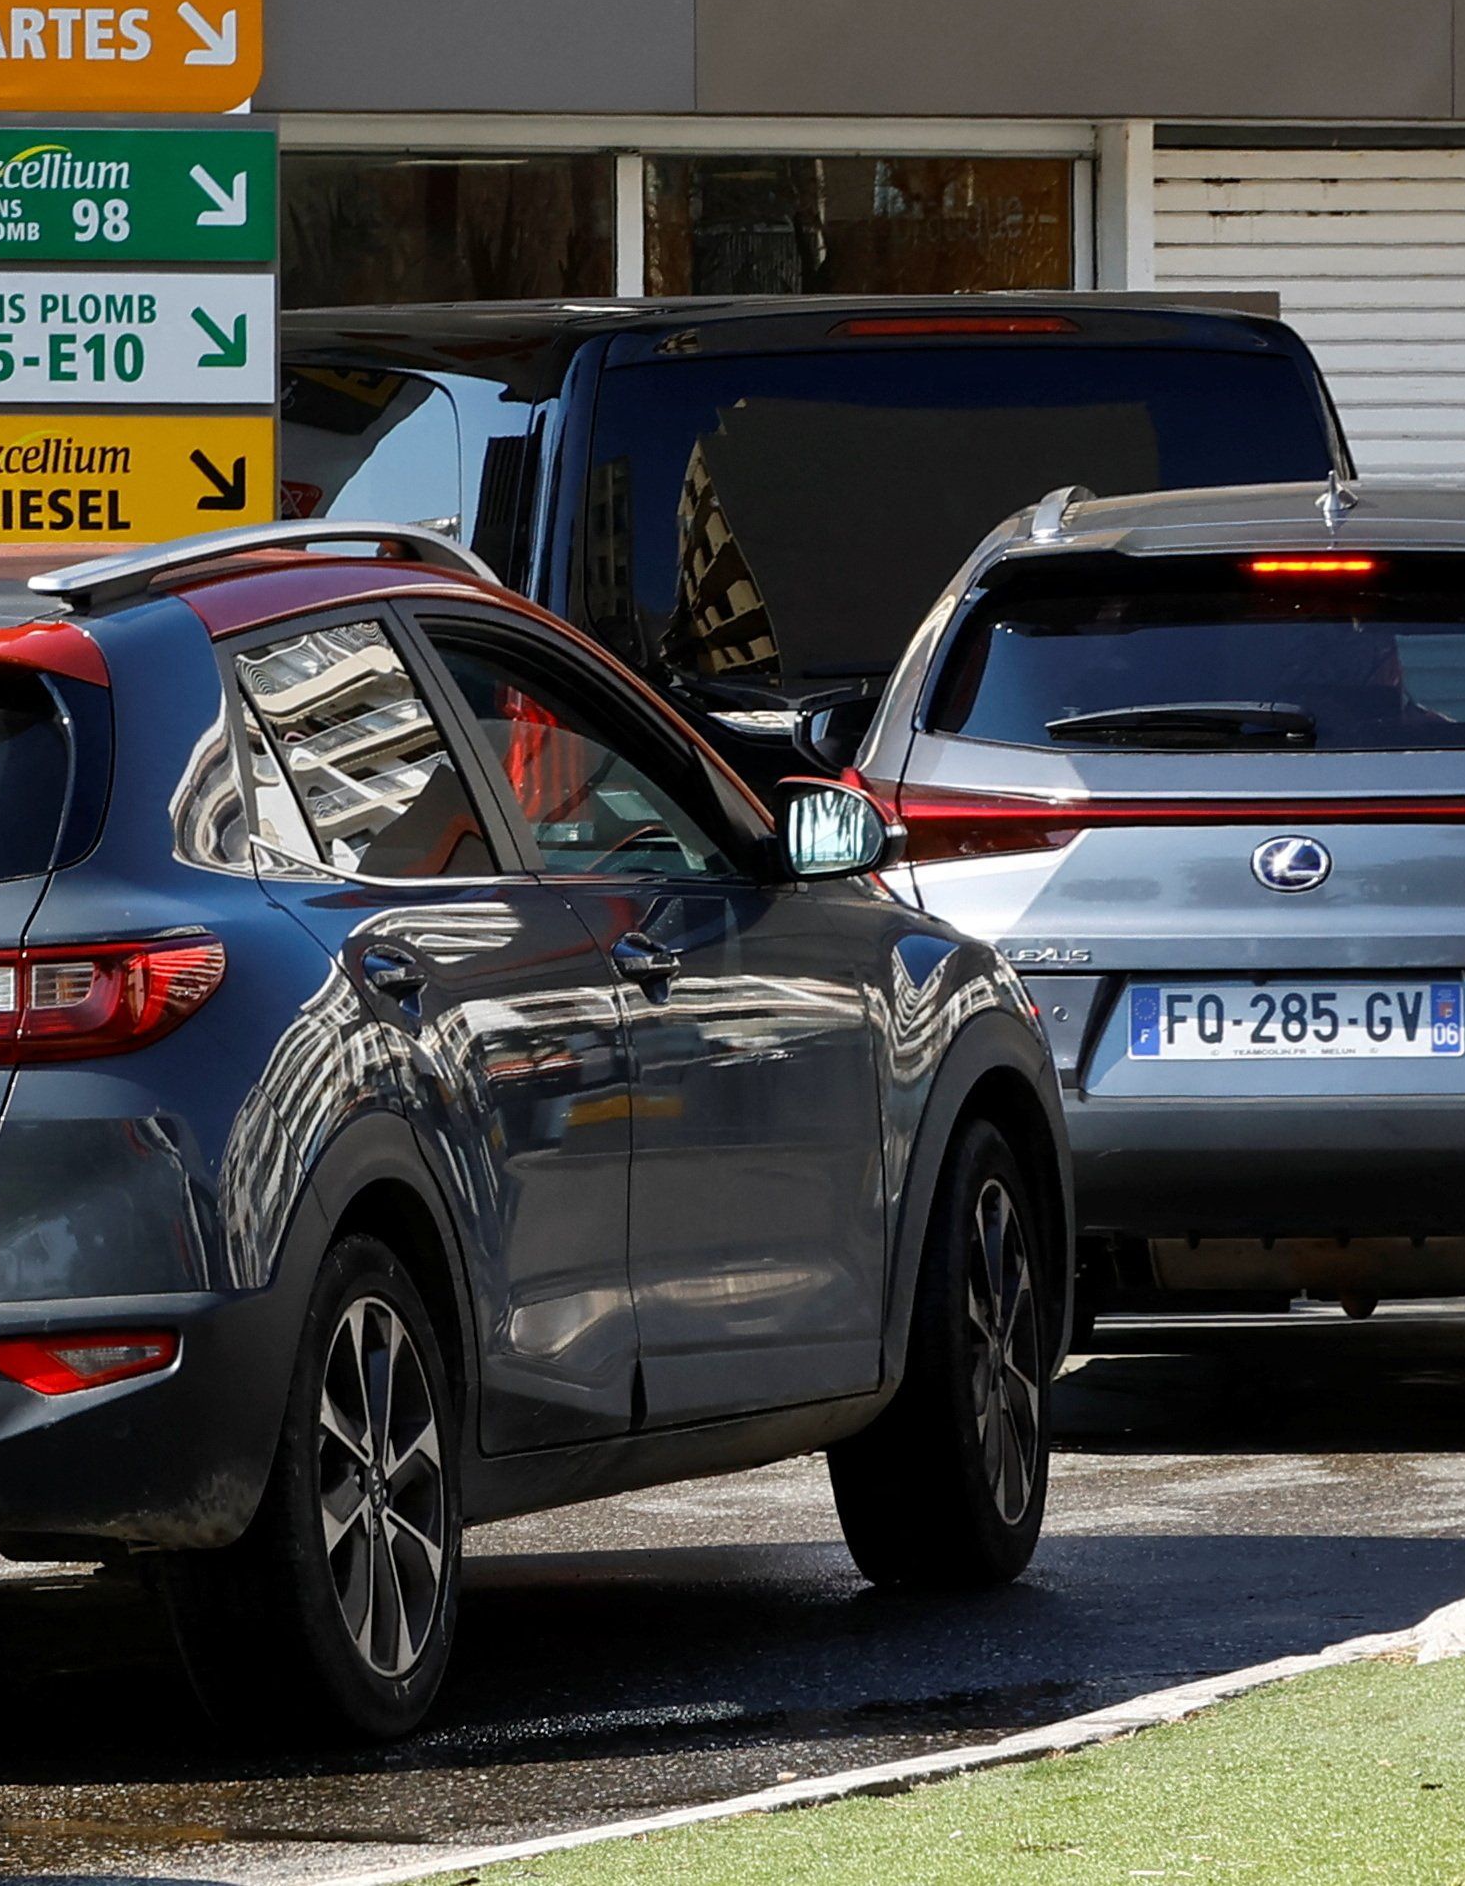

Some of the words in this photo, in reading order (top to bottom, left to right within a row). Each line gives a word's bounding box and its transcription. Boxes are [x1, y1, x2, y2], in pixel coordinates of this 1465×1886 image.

[72, 199, 131, 242] 98
[41, 294, 157, 325] PLOMB
[1166, 992, 1423, 1045] FQ-285-GV
[1140, 1028, 1150, 1043] F
[1433, 1022, 1459, 1045] 06
[1322, 1047, 1356, 1056] MELUN
